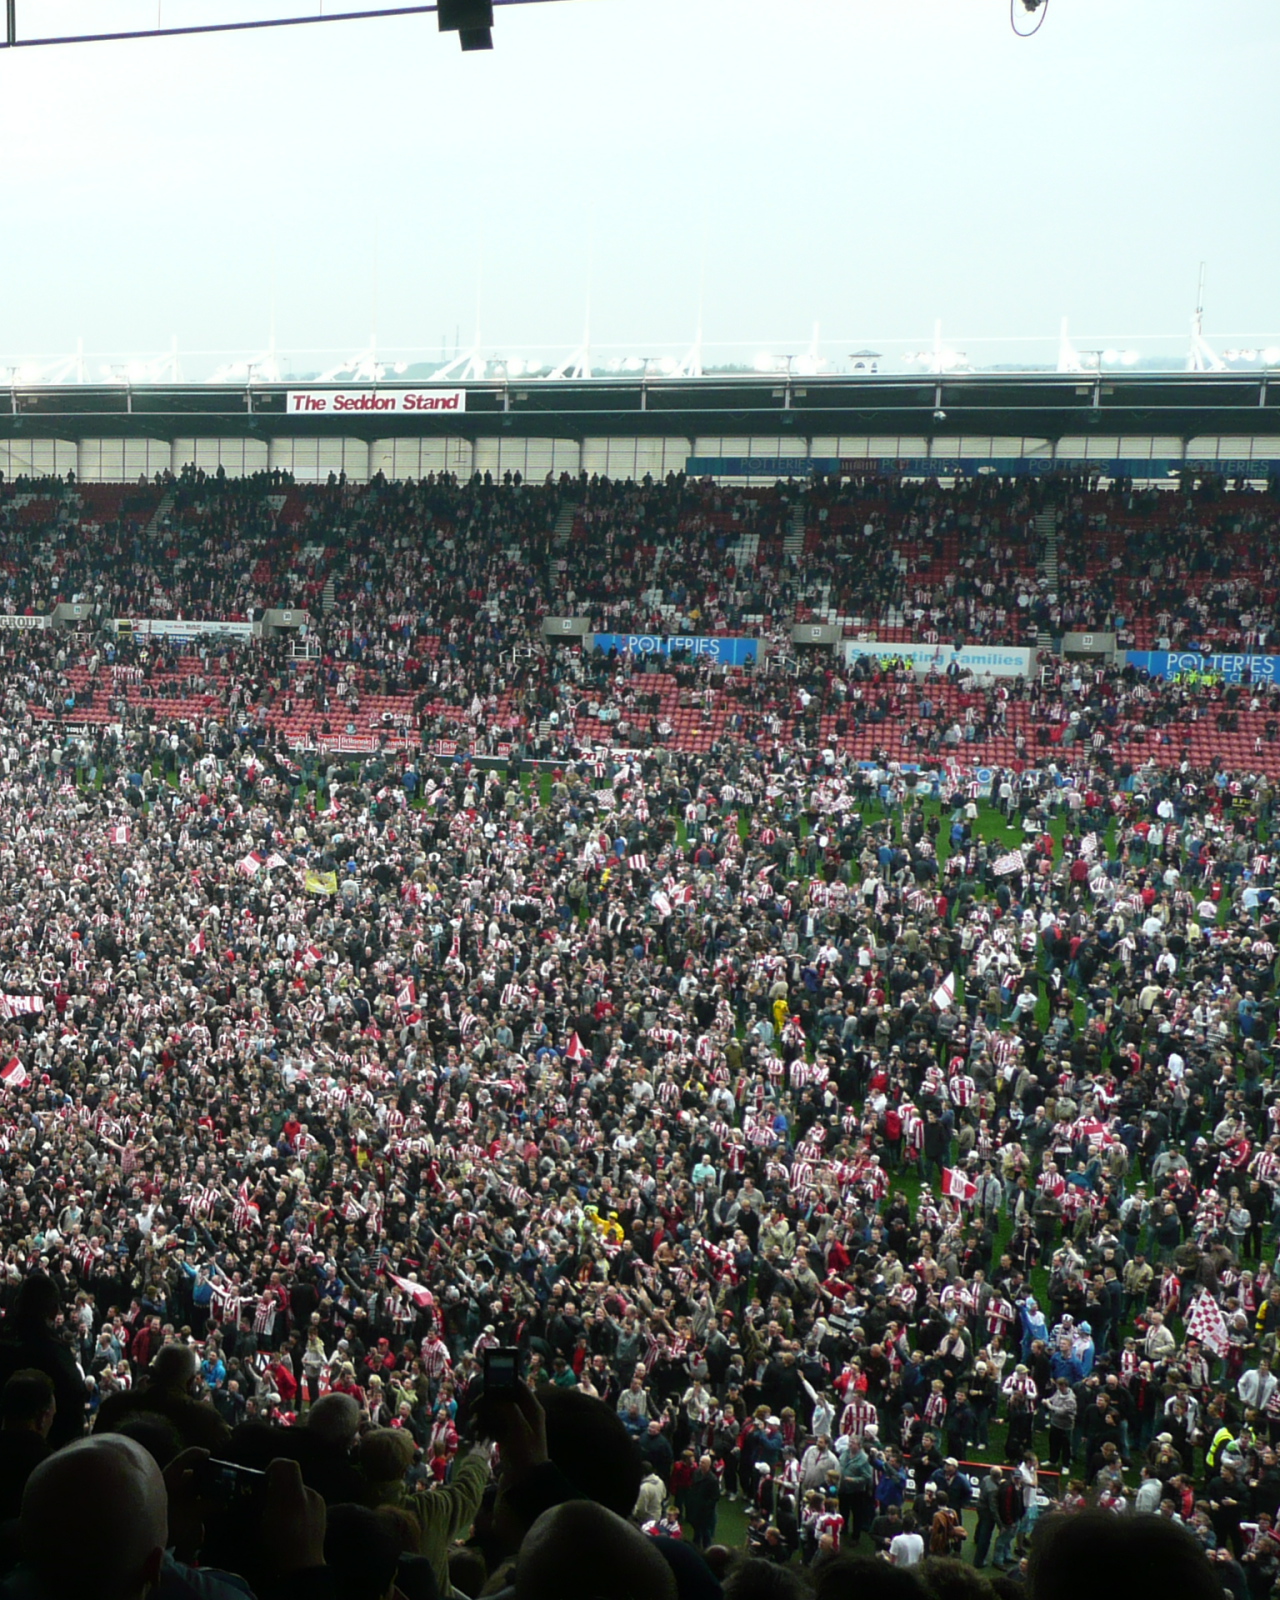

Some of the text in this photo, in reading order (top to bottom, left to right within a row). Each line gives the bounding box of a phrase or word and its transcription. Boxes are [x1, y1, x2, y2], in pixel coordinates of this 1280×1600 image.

[293, 393, 460, 411] The Seddon Stand
[740, 458, 815, 471] POTTERIES
[0, 616, 43, 628] GROUP
[950, 650, 1023, 666] Families
